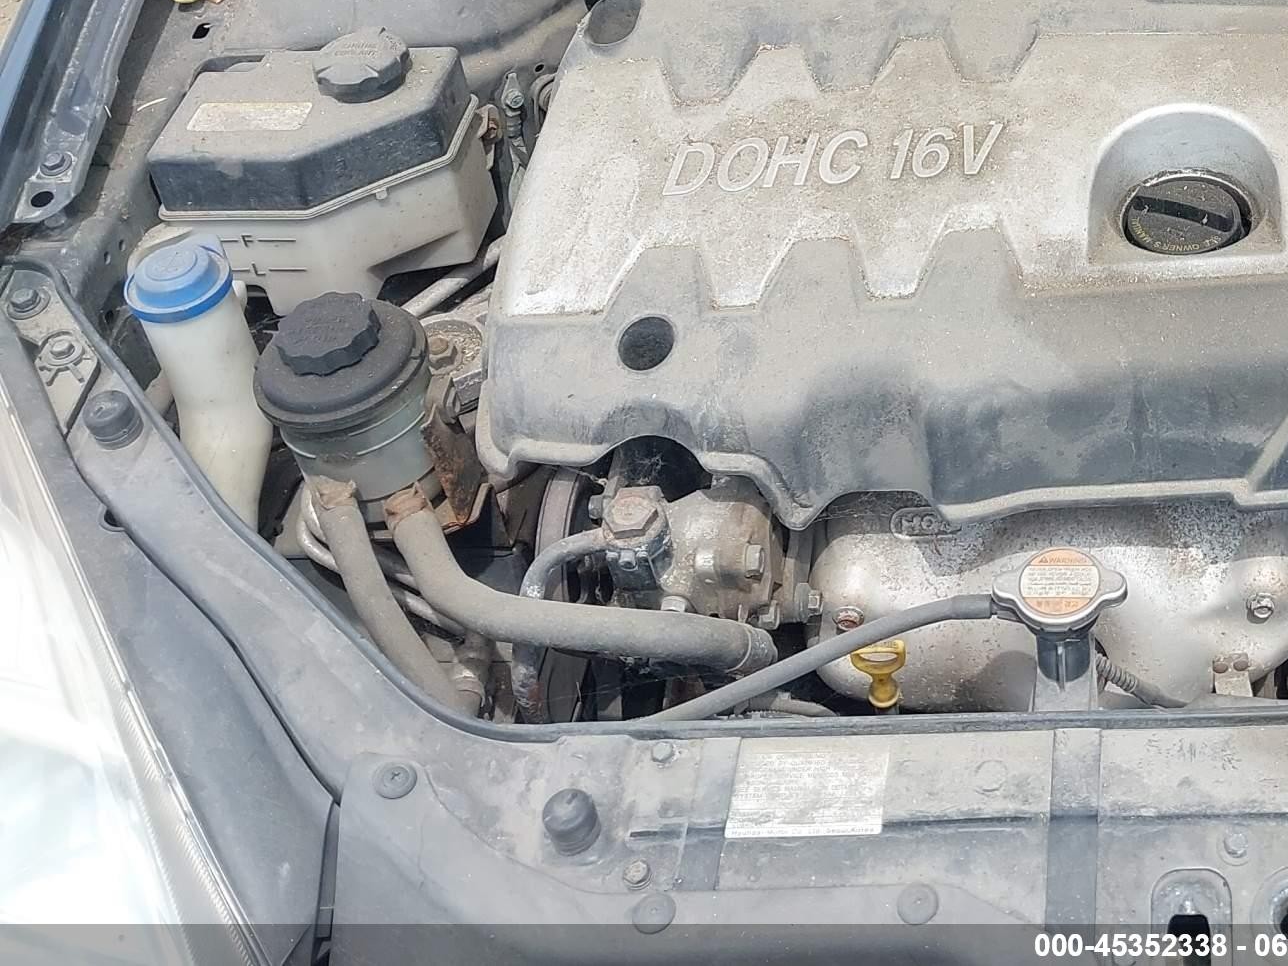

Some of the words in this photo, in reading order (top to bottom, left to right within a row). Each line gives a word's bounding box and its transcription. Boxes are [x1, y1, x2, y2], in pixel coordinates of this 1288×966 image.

[662, 129, 868, 196] DOHC
[889, 121, 1003, 180] 16V
[241, 234, 254, 248] F
[251, 262, 267, 276] L
